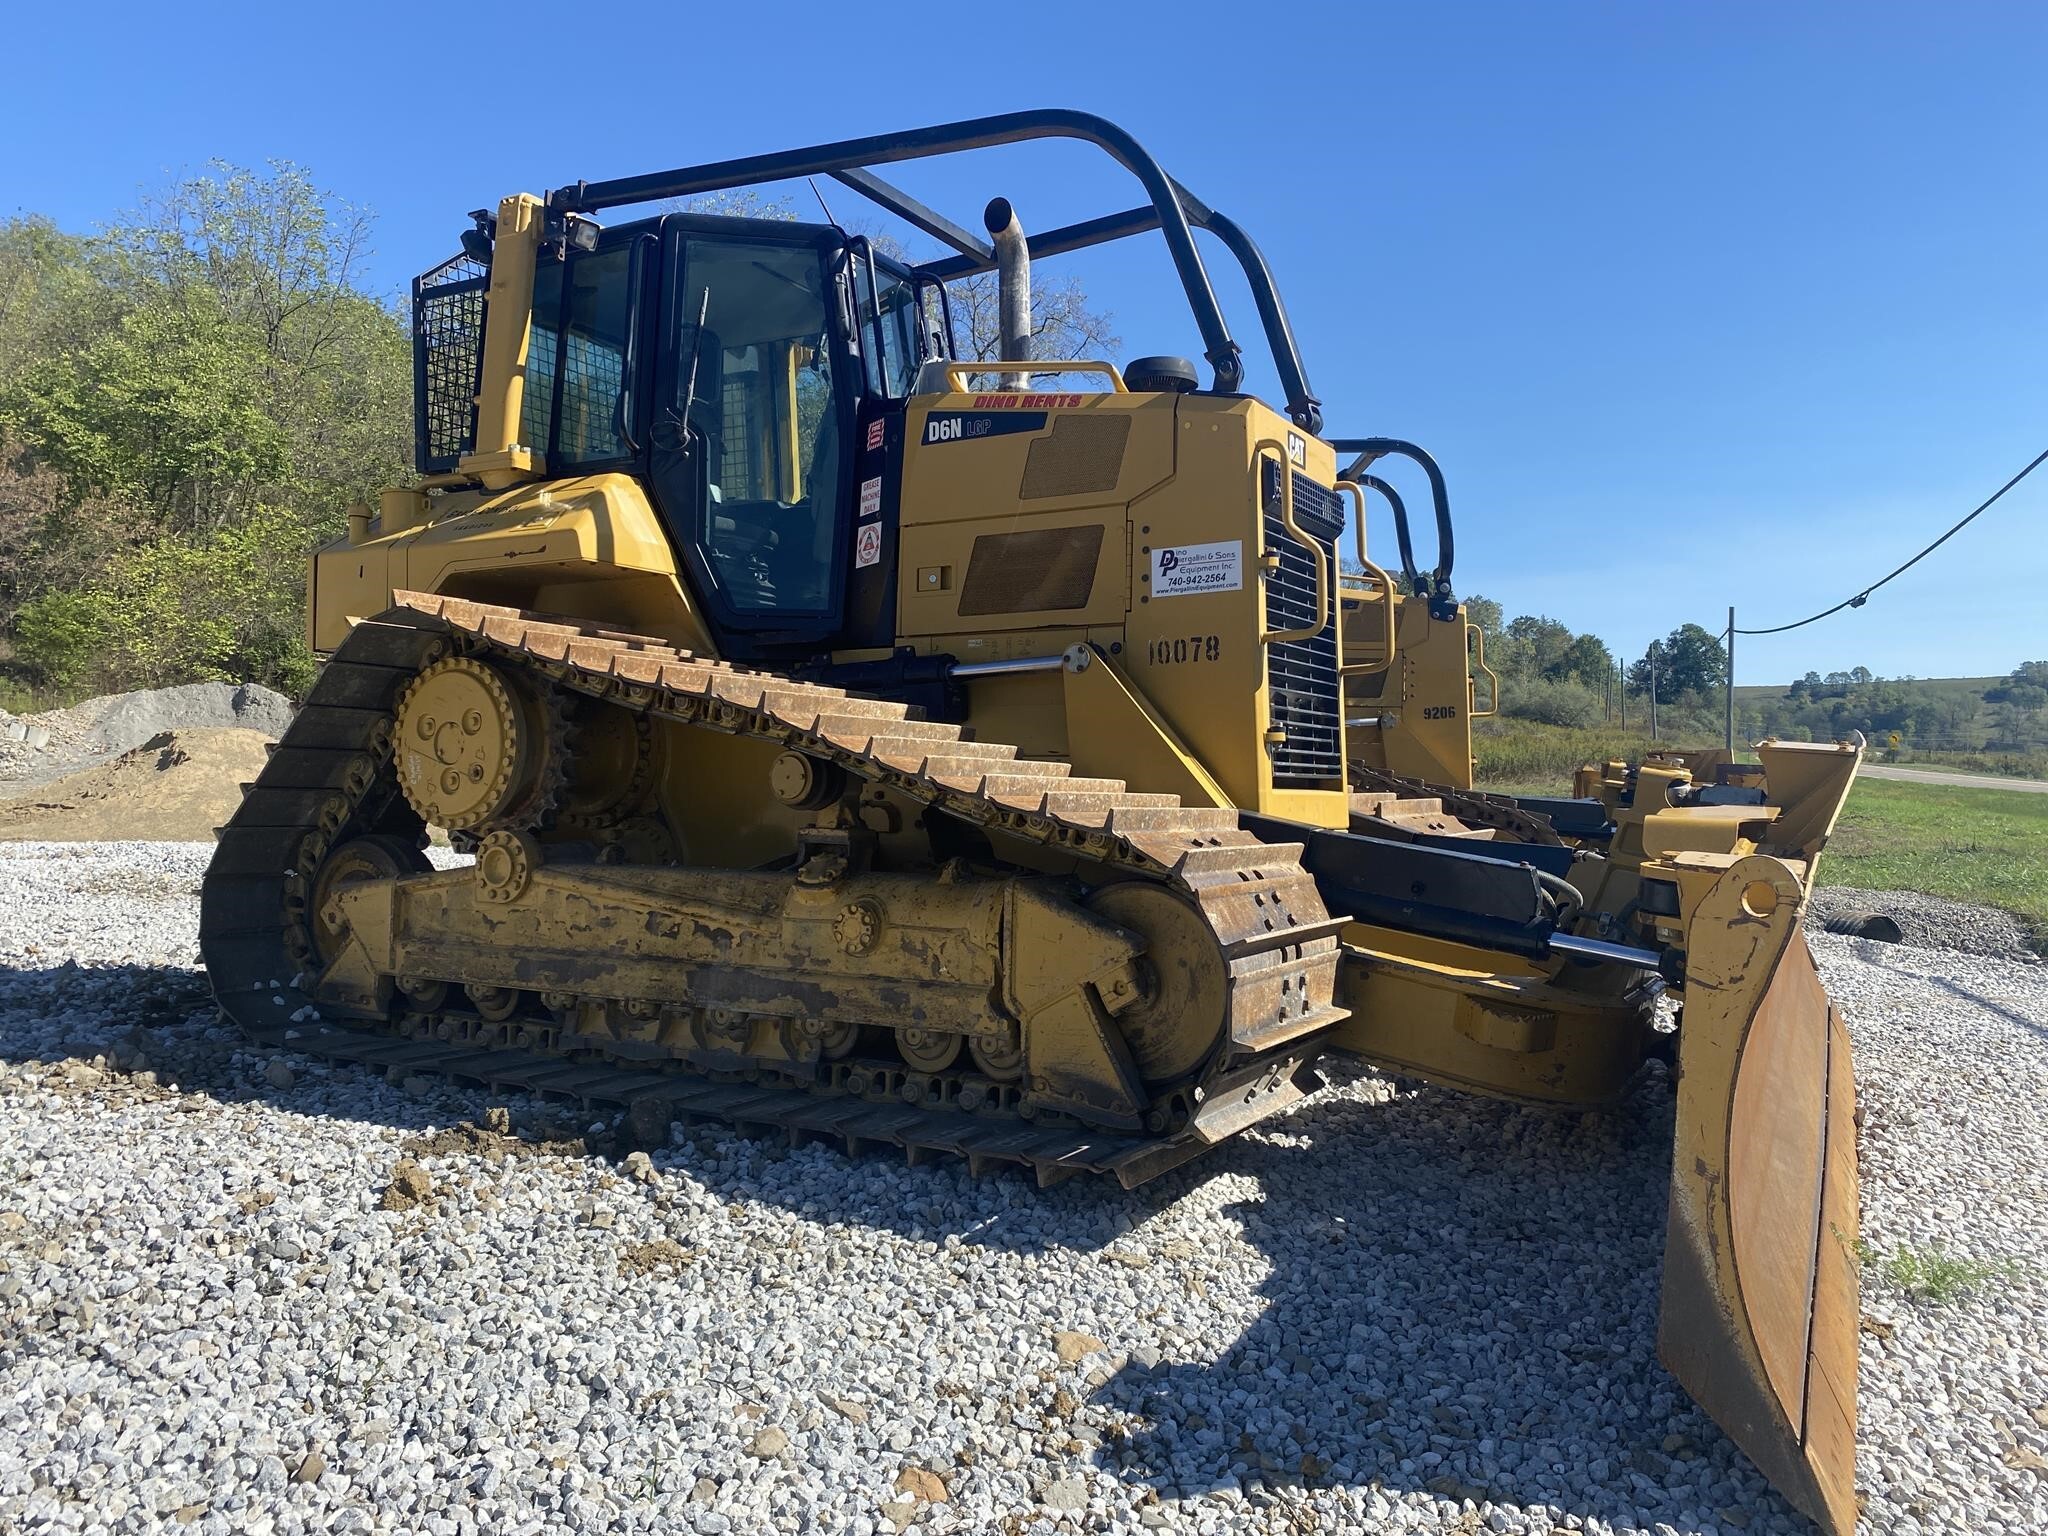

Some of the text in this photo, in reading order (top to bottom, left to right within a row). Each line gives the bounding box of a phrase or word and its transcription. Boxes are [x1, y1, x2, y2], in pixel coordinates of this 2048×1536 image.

[973, 394, 1083, 408] DINO RENTS
[928, 418, 992, 441] D6N LGP
[1289, 433, 1305, 466] CAT
[863, 479, 880, 491] GREASE
[861, 490, 880, 503] MACHINE
[863, 503, 876, 514] DAILY
[1215, 551, 1236, 559] Sons
[1179, 564, 1220, 575] Equipment
[1168, 572, 1227, 587] 740-942-2564
[1149, 635, 1220, 666] 10078
[1423, 705, 1456, 720] 9206
